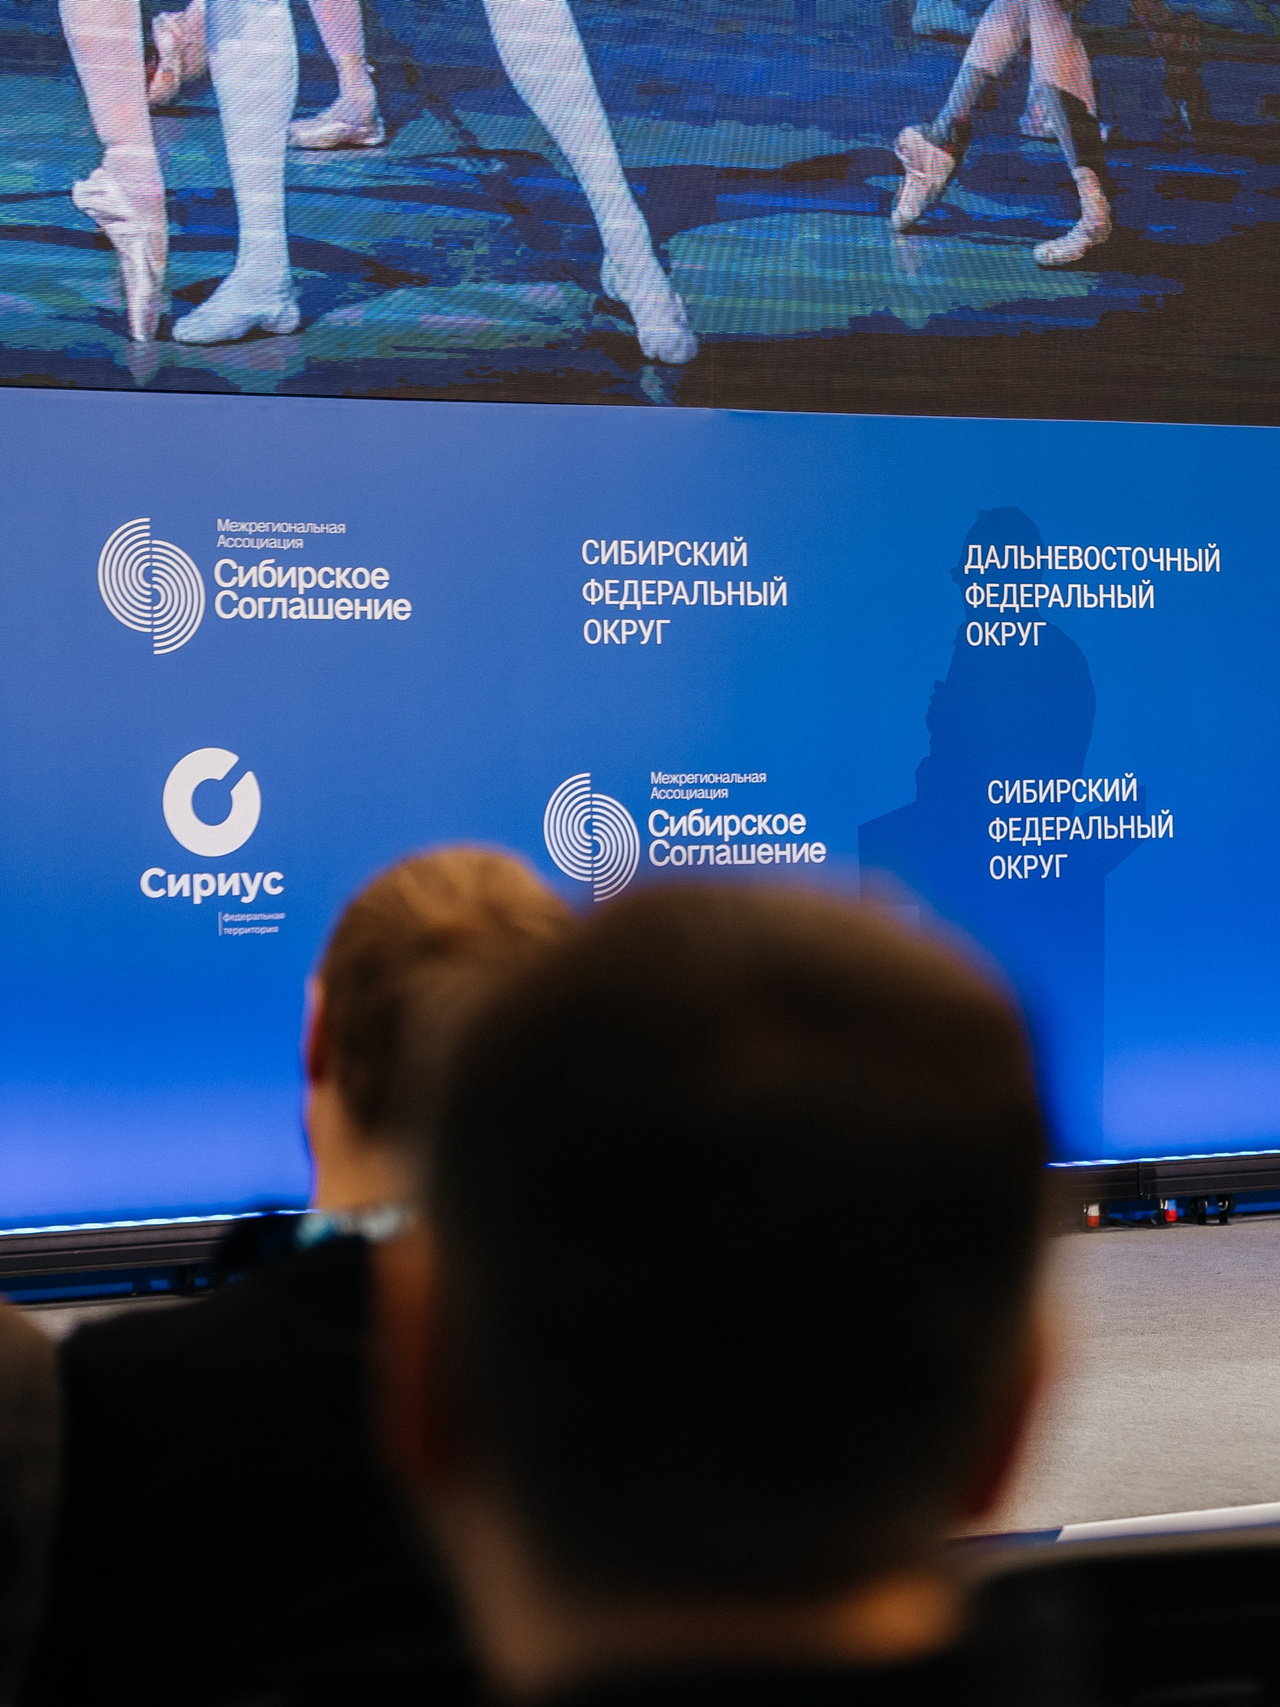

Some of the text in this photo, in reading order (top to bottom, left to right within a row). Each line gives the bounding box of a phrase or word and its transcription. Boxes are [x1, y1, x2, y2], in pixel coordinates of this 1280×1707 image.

[217, 518, 346, 534] Межрегиональная
[216, 535, 304, 550] Ассоциация
[581, 536, 748, 567] СИБИРСКИЙ
[964, 543, 1221, 575] ДАЛЬНЕВОСТОЧНЫЙ
[214, 558, 390, 594] Сибирское
[214, 590, 412, 621] Соглашение
[582, 575, 788, 608] ФЕДЕРАЛЬНЫЙ
[965, 579, 1155, 612] ФЕДЕРАЛЬНЫЙ
[583, 618, 671, 645] ОКРУГ
[966, 621, 1047, 646] ОКРУГ
[650, 771, 767, 786] Межрегиональная
[988, 772, 1138, 804] СИБИРСКИЙ
[650, 787, 729, 801] Ассоциация
[648, 808, 807, 842] Сибирское
[988, 809, 1174, 846] ФЕДЕРАЛЬНЫЙ
[648, 839, 827, 867] Соглашение
[989, 854, 1068, 880] ОКРУГ
[140, 866, 284, 905] Сириус
[222, 912, 286, 923] федеральная
[223, 926, 279, 936] территория
